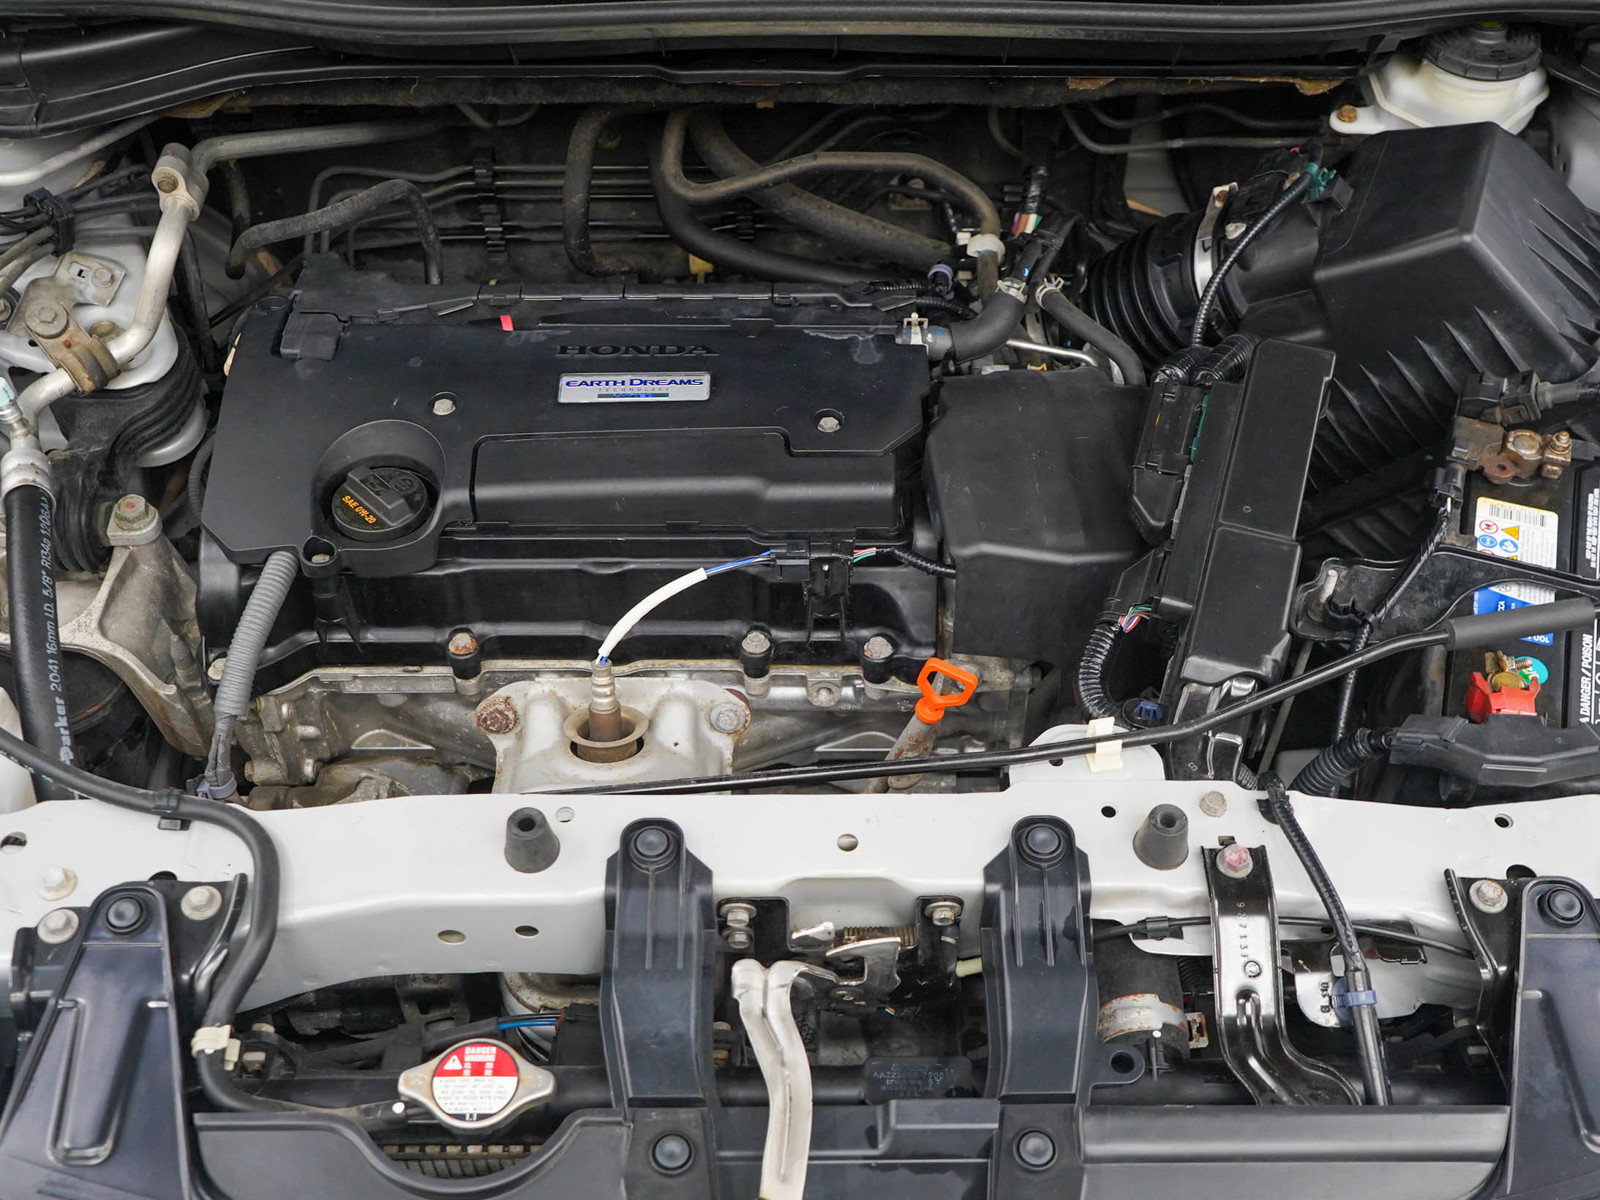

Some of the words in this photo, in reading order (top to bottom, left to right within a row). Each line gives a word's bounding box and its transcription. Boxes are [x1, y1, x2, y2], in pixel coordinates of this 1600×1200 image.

[554, 344, 720, 357] HONDA
[565, 379, 626, 388] EARTH
[629, 377, 704, 388] DREAMS
[342, 495, 359, 509] SAE
[355, 507, 376, 523] 0W-20
[44, 621, 58, 656] 16mm
[47, 658, 63, 693] 2041
[53, 696, 74, 765] Parker
[465, 1047, 497, 1055] DANGER
